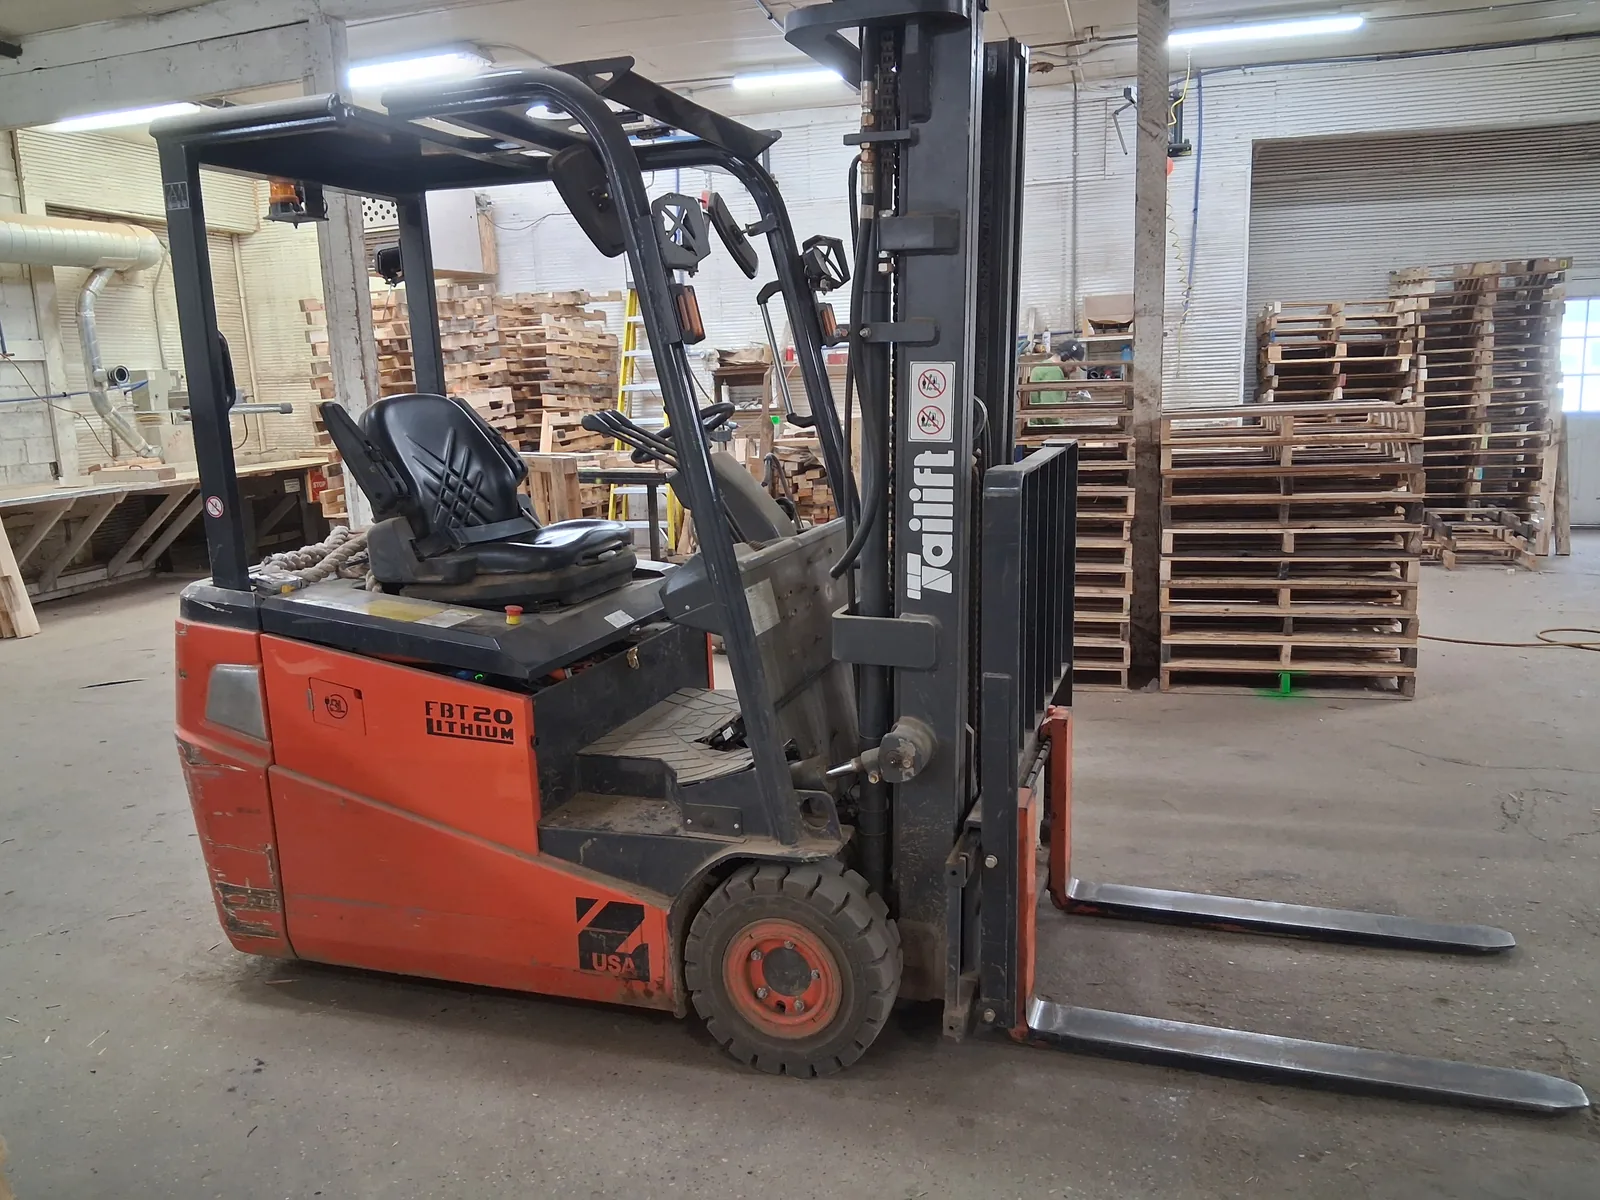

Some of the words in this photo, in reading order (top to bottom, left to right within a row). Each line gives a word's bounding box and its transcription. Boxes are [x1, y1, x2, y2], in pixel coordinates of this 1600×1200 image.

[313, 481, 326, 489] STOP
[907, 450, 955, 600] Tailift
[425, 717, 514, 745] LITHIUM
[591, 952, 637, 977] USA
